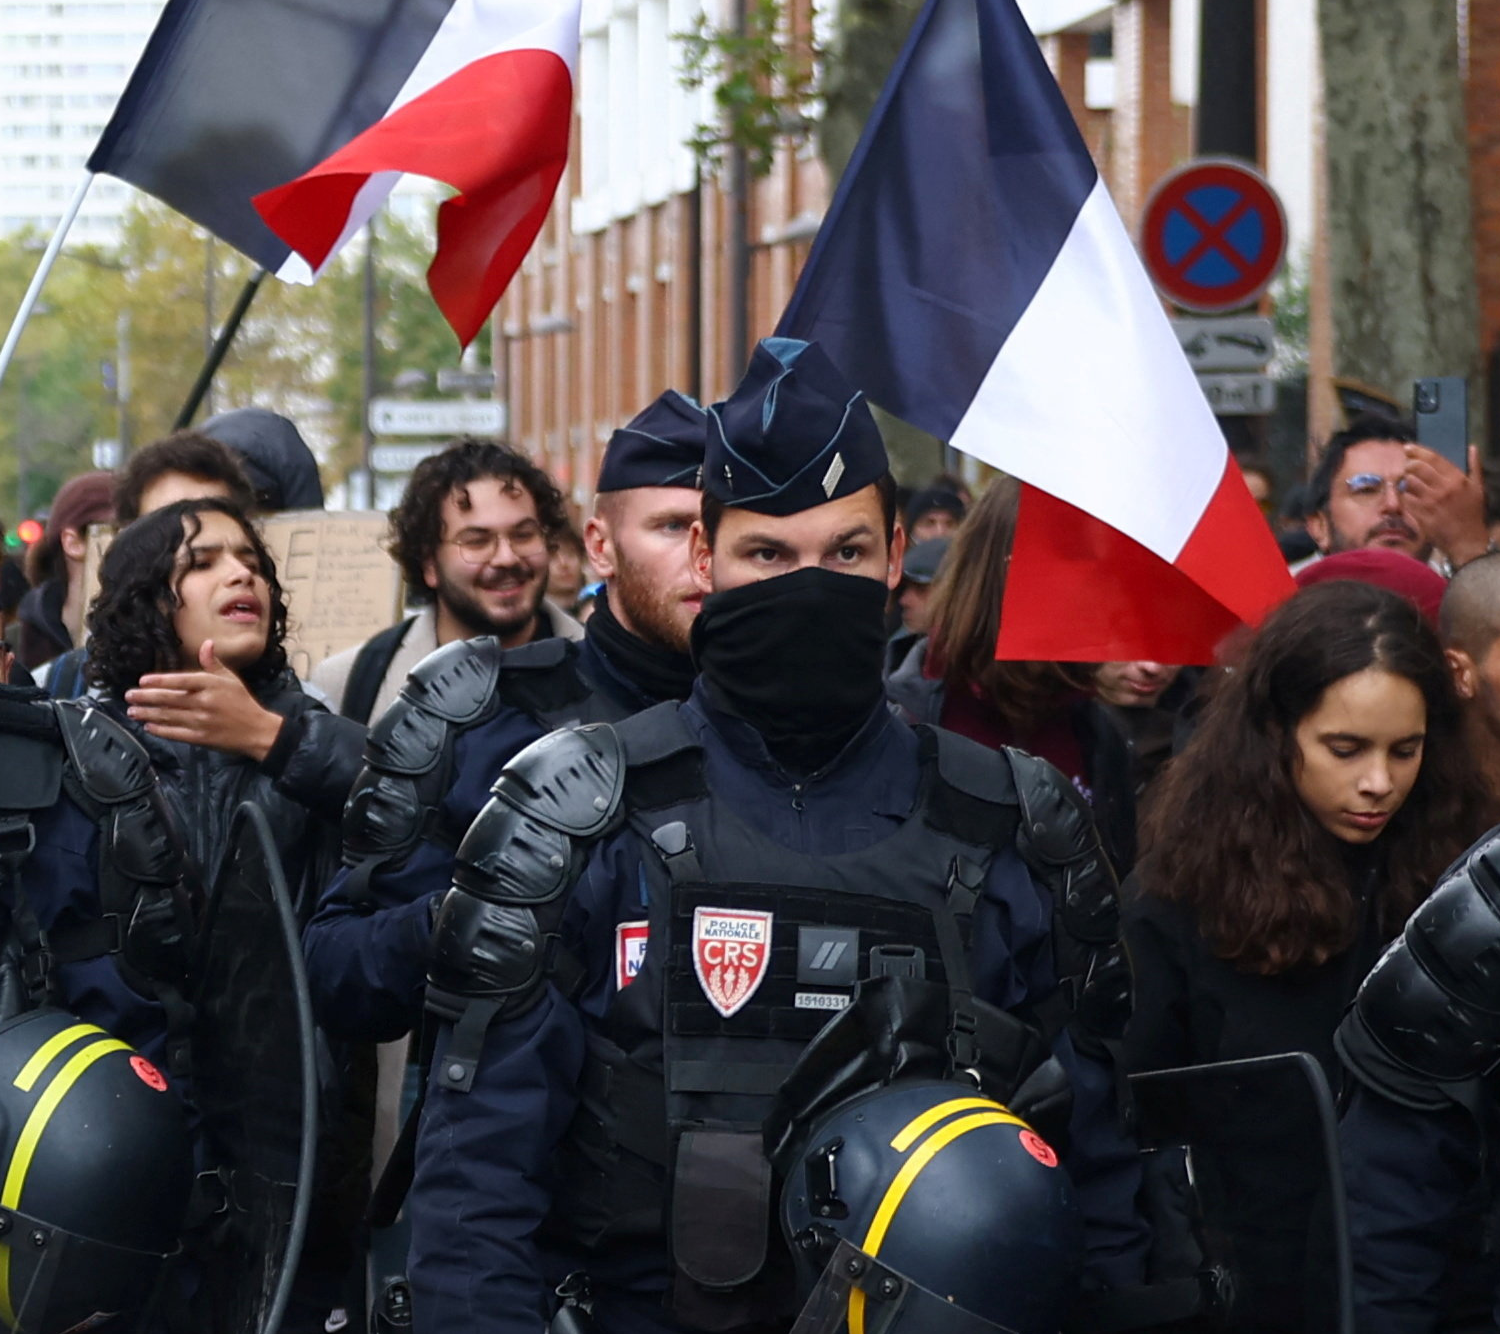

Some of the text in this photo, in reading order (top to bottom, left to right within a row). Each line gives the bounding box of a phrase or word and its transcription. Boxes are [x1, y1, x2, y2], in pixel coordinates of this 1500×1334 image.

[710, 920, 757, 931] POLICE
[704, 928, 761, 940] NATIONALE
[703, 942, 759, 968] CRS
